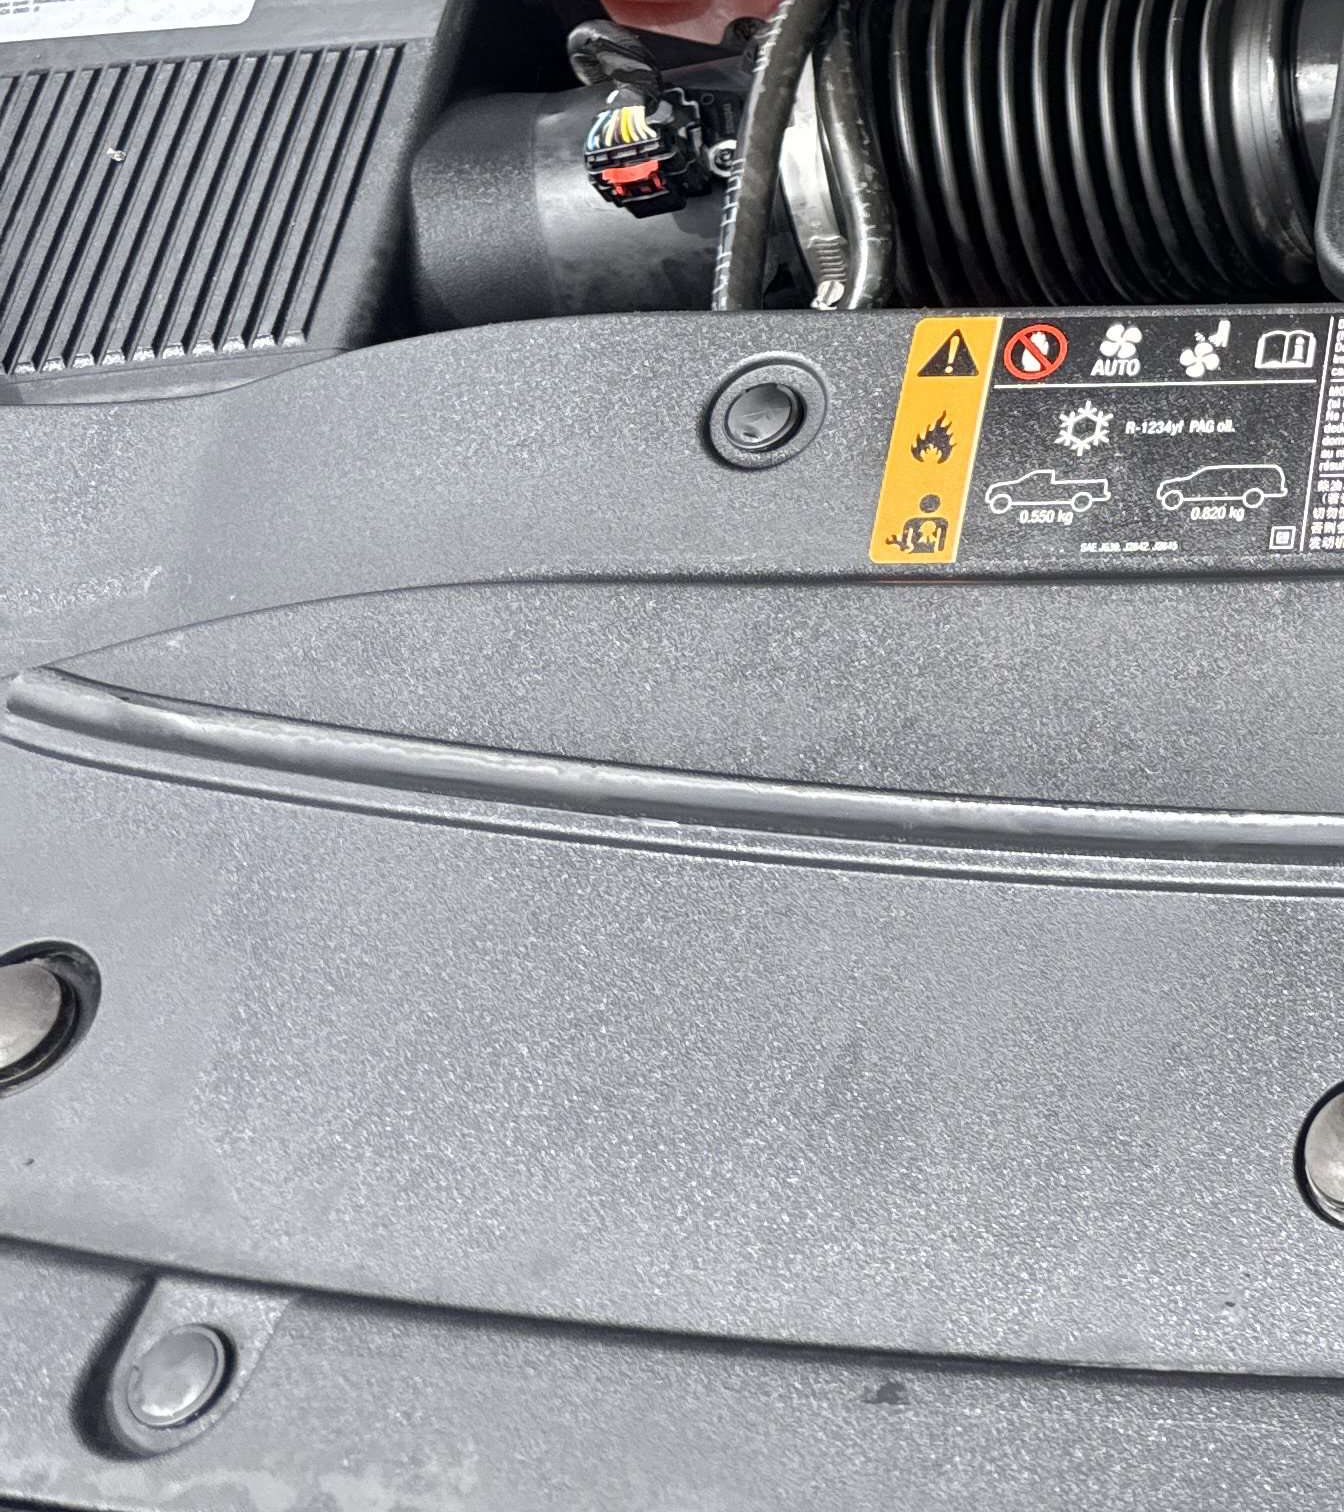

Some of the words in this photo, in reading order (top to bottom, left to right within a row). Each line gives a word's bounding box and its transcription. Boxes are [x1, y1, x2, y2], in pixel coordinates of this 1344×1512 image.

[1090, 358, 1141, 377] AUTO
[1125, 422, 1183, 435] R-1234yf
[1189, 420, 1214, 433] PAG
[1321, 450, 1334, 458] au
[1019, 509, 1055, 523] 0.550
[1057, 508, 1073, 525] kg
[1191, 506, 1226, 520] 0.820
[1228, 506, 1245, 521] kg
[1080, 542, 1097, 552] SAE
